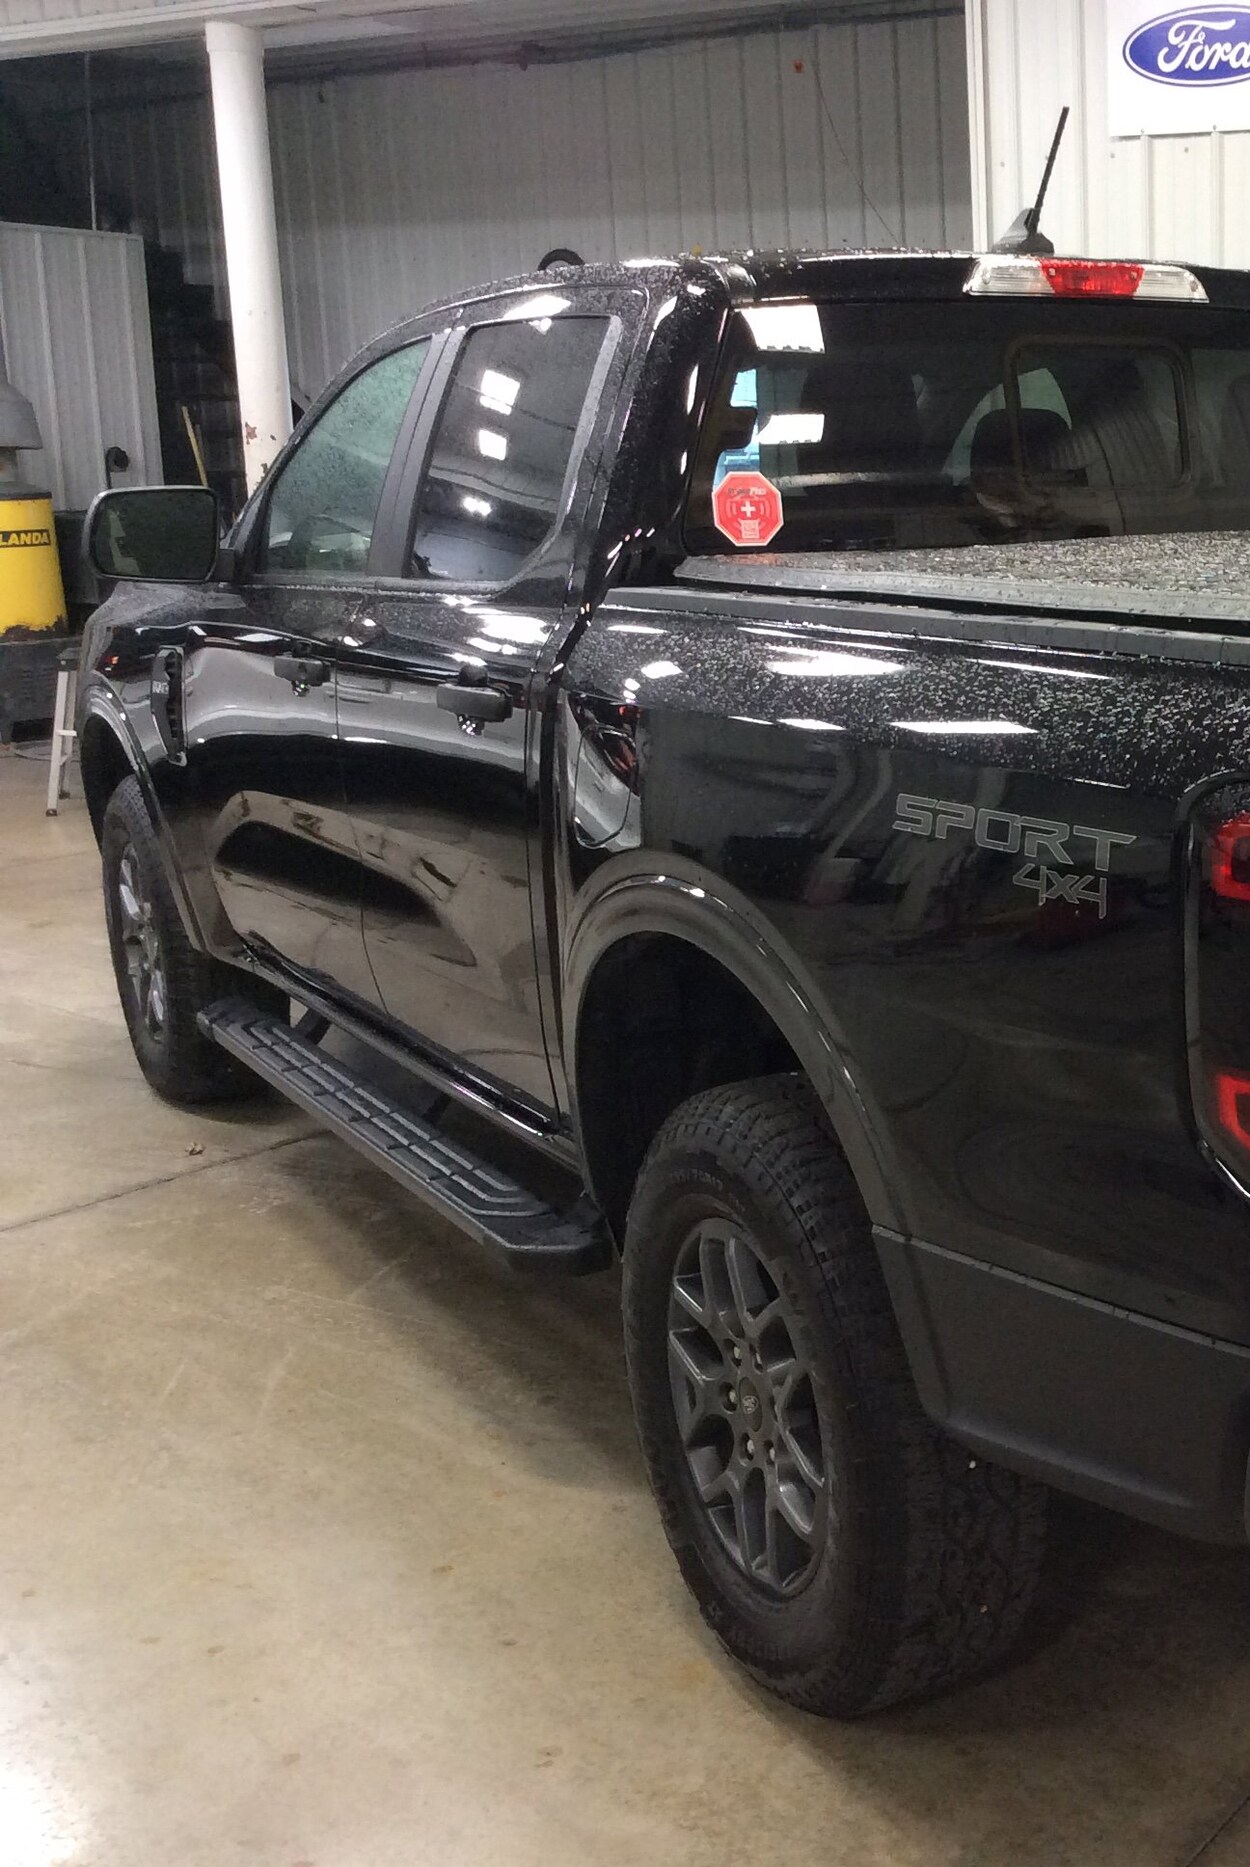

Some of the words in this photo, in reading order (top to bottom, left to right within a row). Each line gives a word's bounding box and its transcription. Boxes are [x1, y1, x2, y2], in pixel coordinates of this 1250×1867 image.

[0, 531, 50, 546] LANDA
[892, 792, 1138, 872] SPORT
[1012, 862, 1109, 920] 4x4
